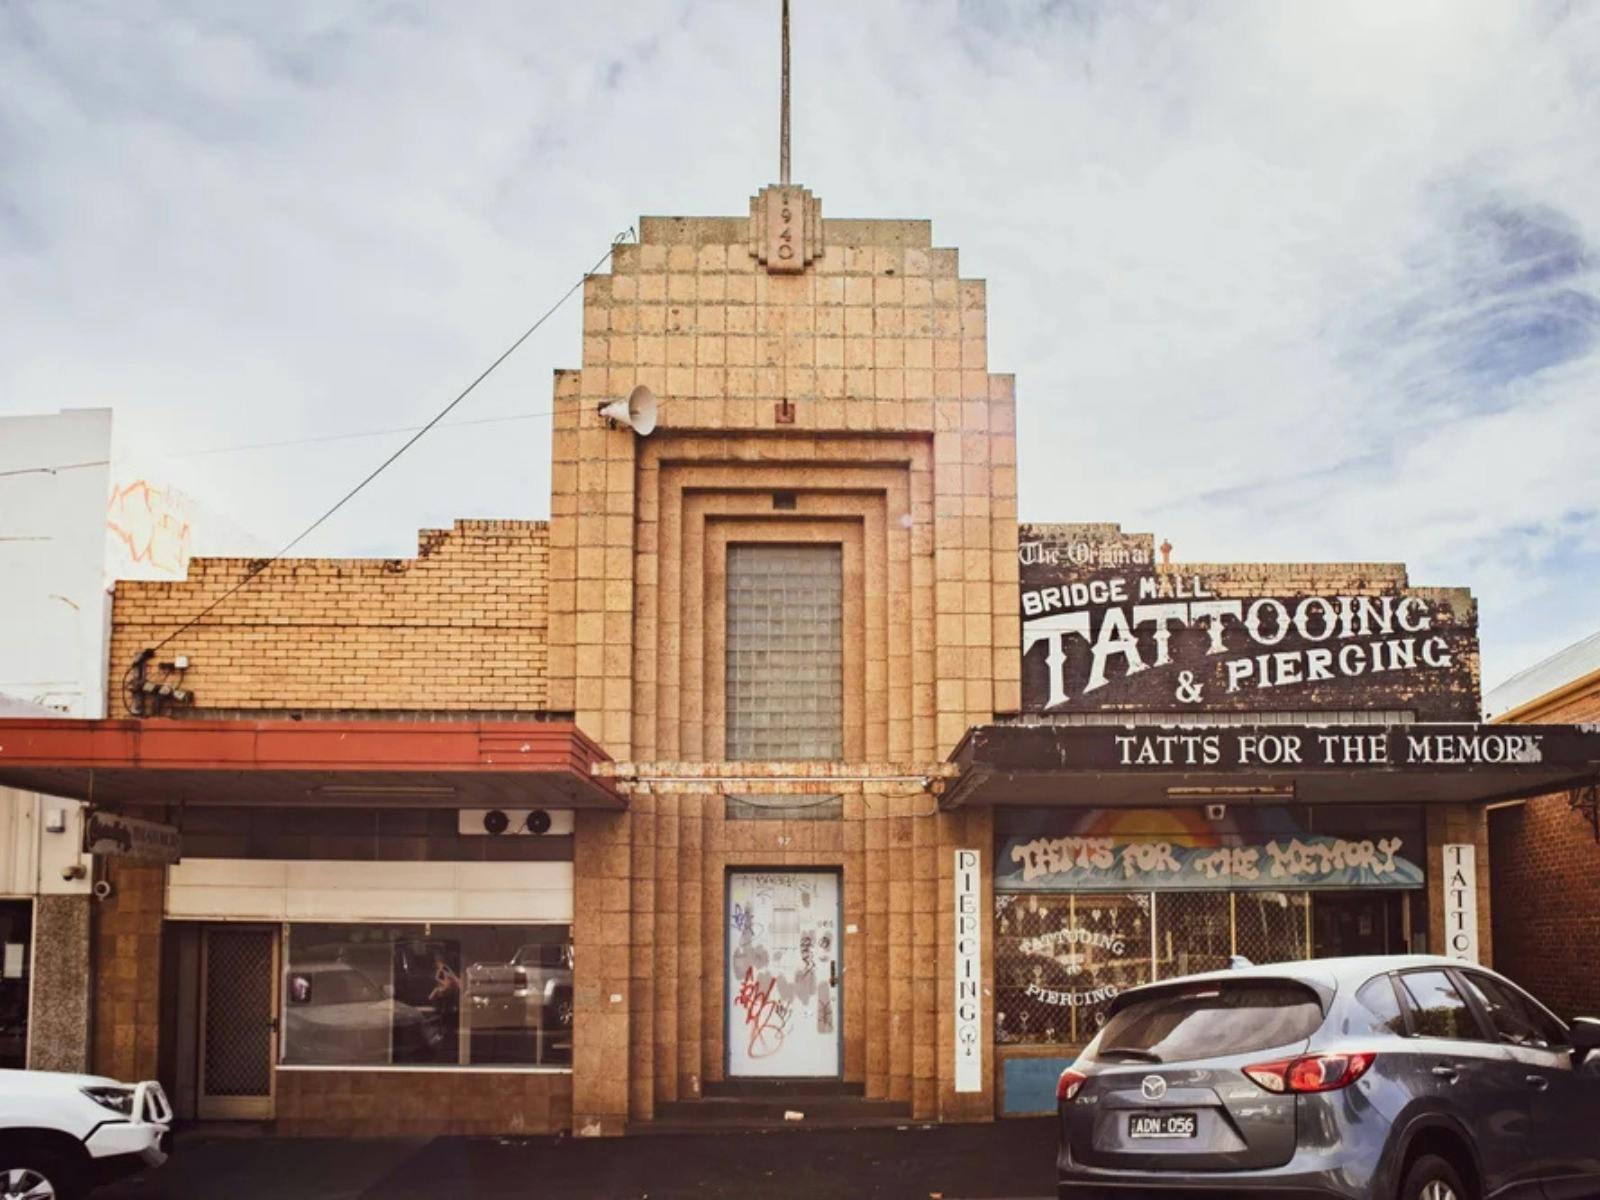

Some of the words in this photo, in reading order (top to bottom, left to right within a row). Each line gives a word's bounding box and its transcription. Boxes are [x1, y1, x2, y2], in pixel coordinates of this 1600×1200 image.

[1019, 542, 1060, 565] The
[1022, 578, 1129, 616] BRIDGE
[1139, 574, 1213, 600] MALL
[1022, 596, 1432, 710] TATTOOING
[1175, 671, 1204, 703] &
[1226, 636, 1453, 694] PIERCING
[1116, 735, 1220, 765] TATTS
[1238, 735, 1302, 764] FOR
[1318, 734, 1389, 763] THE
[1011, 837, 1114, 881] TATTS
[1123, 843, 1181, 879] FOR
[1194, 848, 1259, 879] THE
[1266, 837, 1402, 878] MEMORY
[1450, 846, 1470, 961] TATTO
[958, 851, 977, 1022] PIERCING
[1025, 982, 1118, 1006] PIERCING
